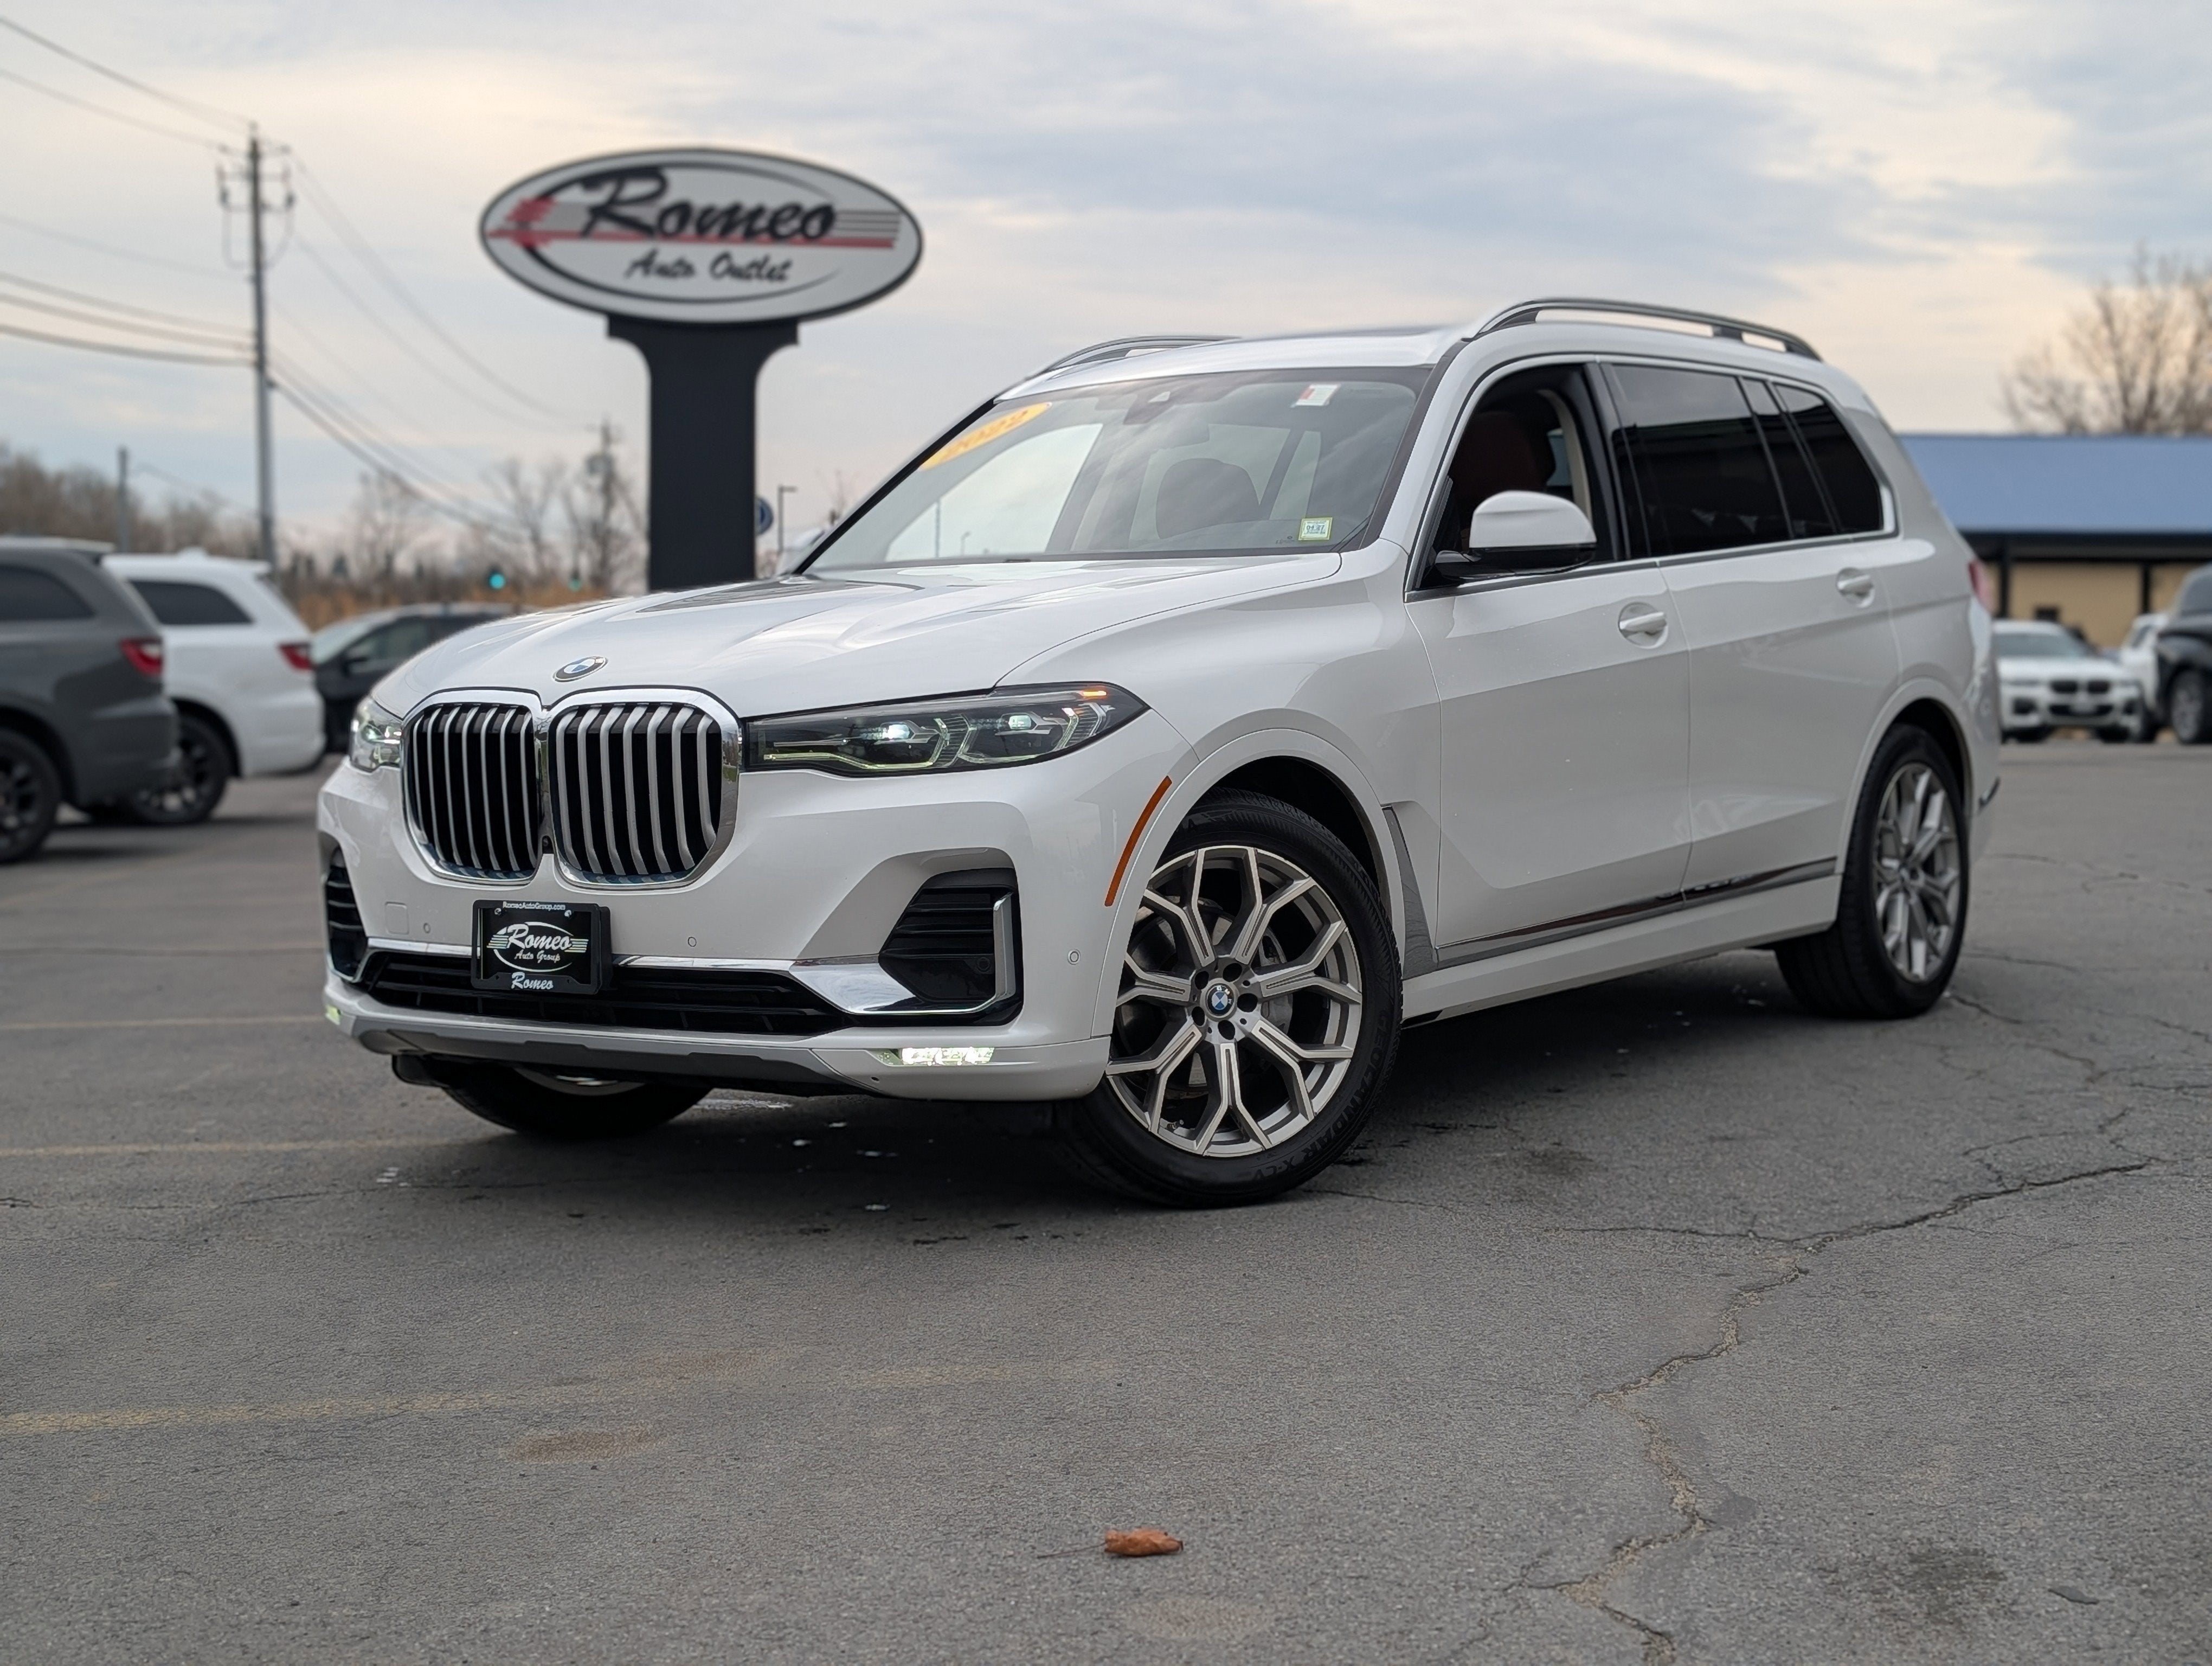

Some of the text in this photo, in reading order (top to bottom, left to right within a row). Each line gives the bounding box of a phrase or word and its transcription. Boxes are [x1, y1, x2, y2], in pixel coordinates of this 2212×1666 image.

[579, 167, 837, 240] Romeo
[624, 249, 793, 282] Auto Outlet
[506, 924, 572, 950] Romeo
[514, 949, 561, 963] Auto Group
[511, 971, 554, 990] Romeo
[1303, 1012, 1388, 1159] GEOLANDAR
